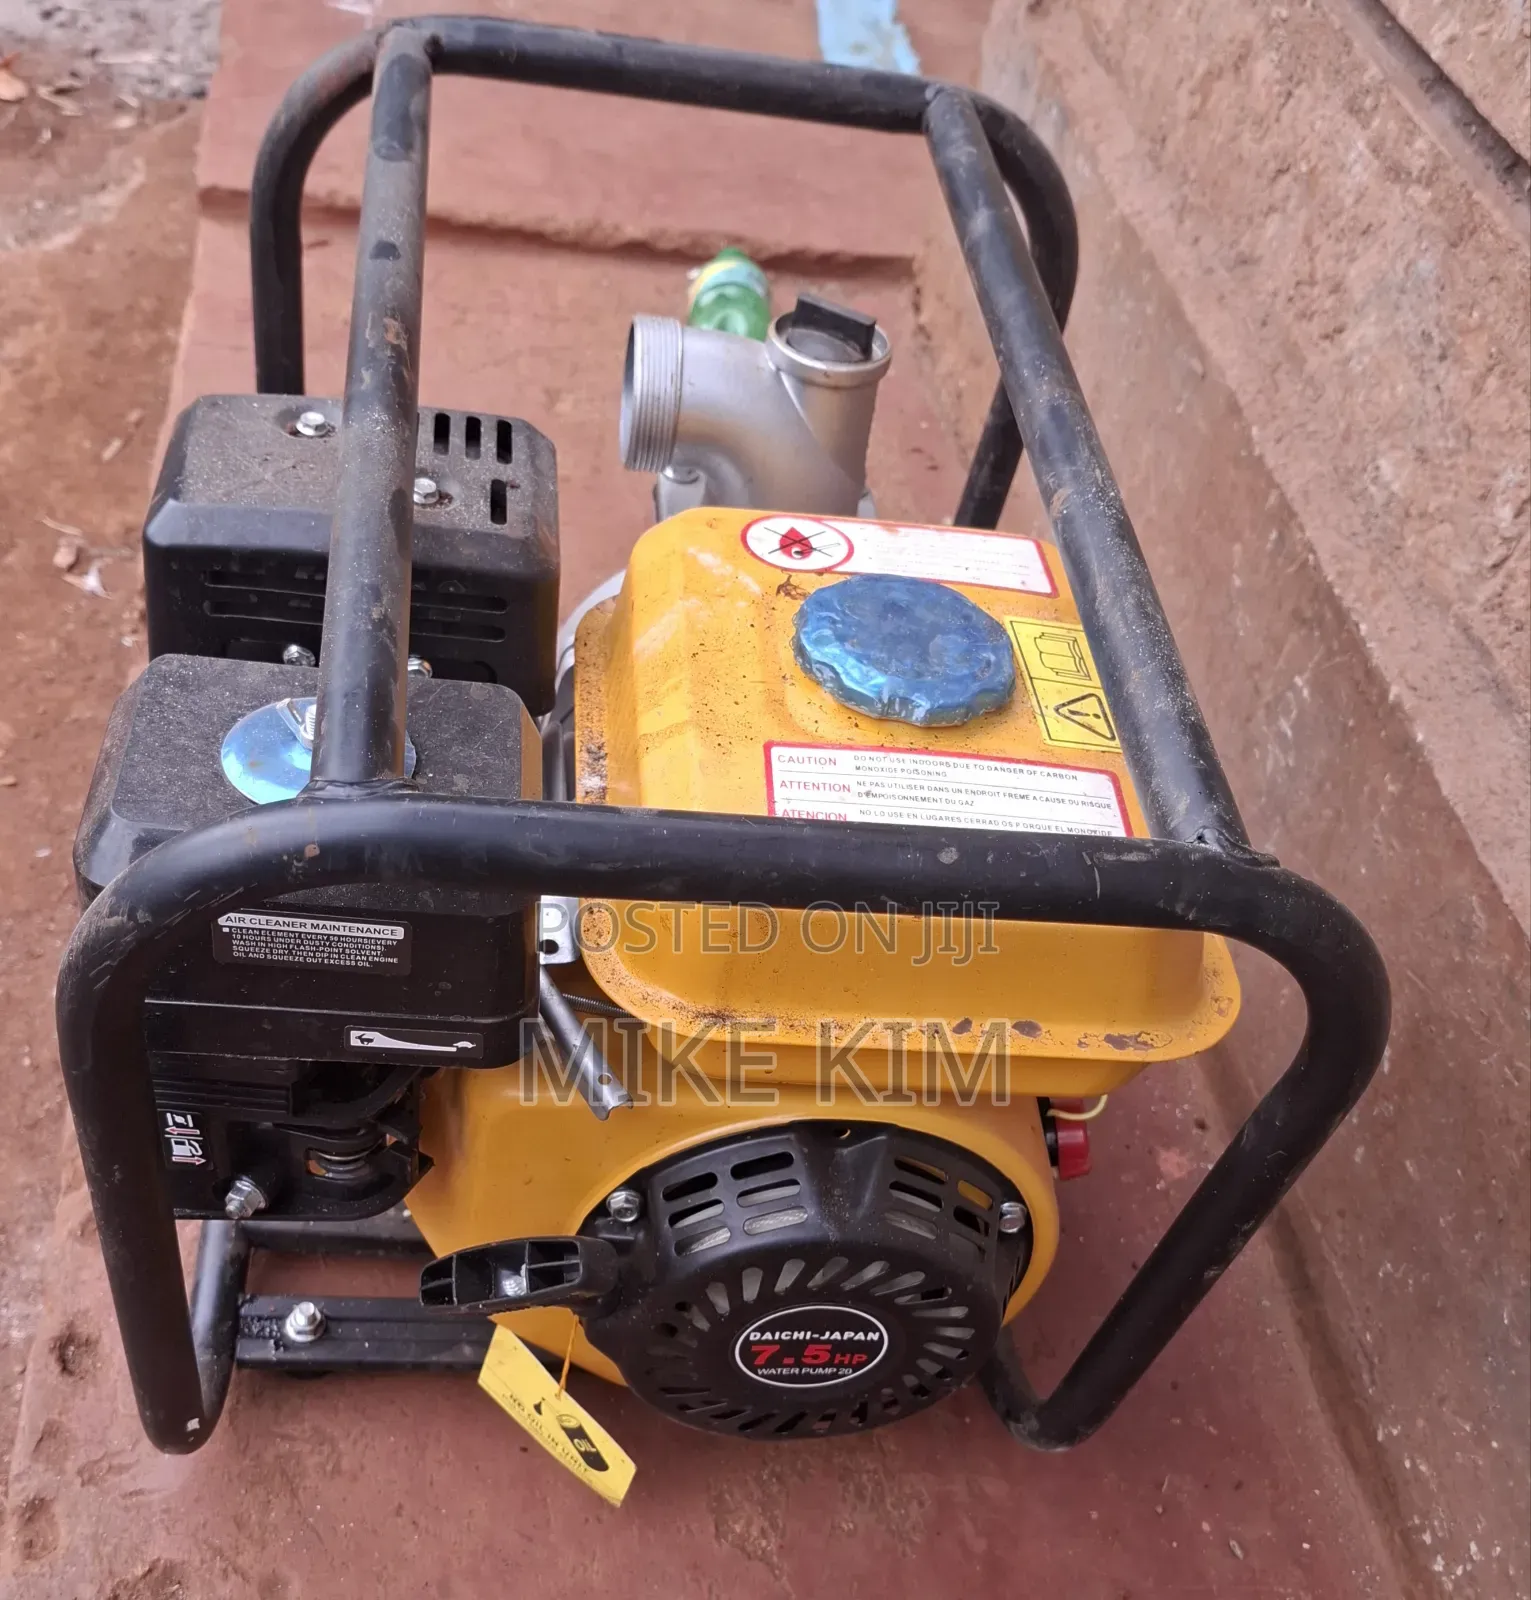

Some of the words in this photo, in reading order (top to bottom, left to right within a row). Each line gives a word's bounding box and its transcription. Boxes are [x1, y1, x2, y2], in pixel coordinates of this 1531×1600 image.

[778, 754, 836, 766] CAUTION
[953, 762, 970, 770] DUE
[987, 766, 1024, 774] DANGER
[1040, 770, 1078, 780] CARBON
[780, 780, 850, 792] ATTENTION
[888, 783, 924, 791] UTILISER
[928, 785, 950, 793] DANS
[965, 789, 1000, 798] ENDROIT
[1039, 796, 1066, 804] CAUSE
[1081, 801, 1112, 810] RISQUE
[782, 808, 847, 821] ATENCION
[921, 813, 962, 822] LUGARES
[225, 916, 246, 924] AIR
[250, 918, 307, 929] CLEANER
[311, 923, 398, 936] MAINTENANCE
[261, 930, 299, 938] ELEMENT
[274, 936, 301, 944] UNDER
[290, 944, 343, 953] FLASH-POINT
[267, 954, 304, 962] SQUEEZE
[749, 1331, 880, 1341] DAICHI-JAPAN
[574, 1438, 597, 1452] OIL
